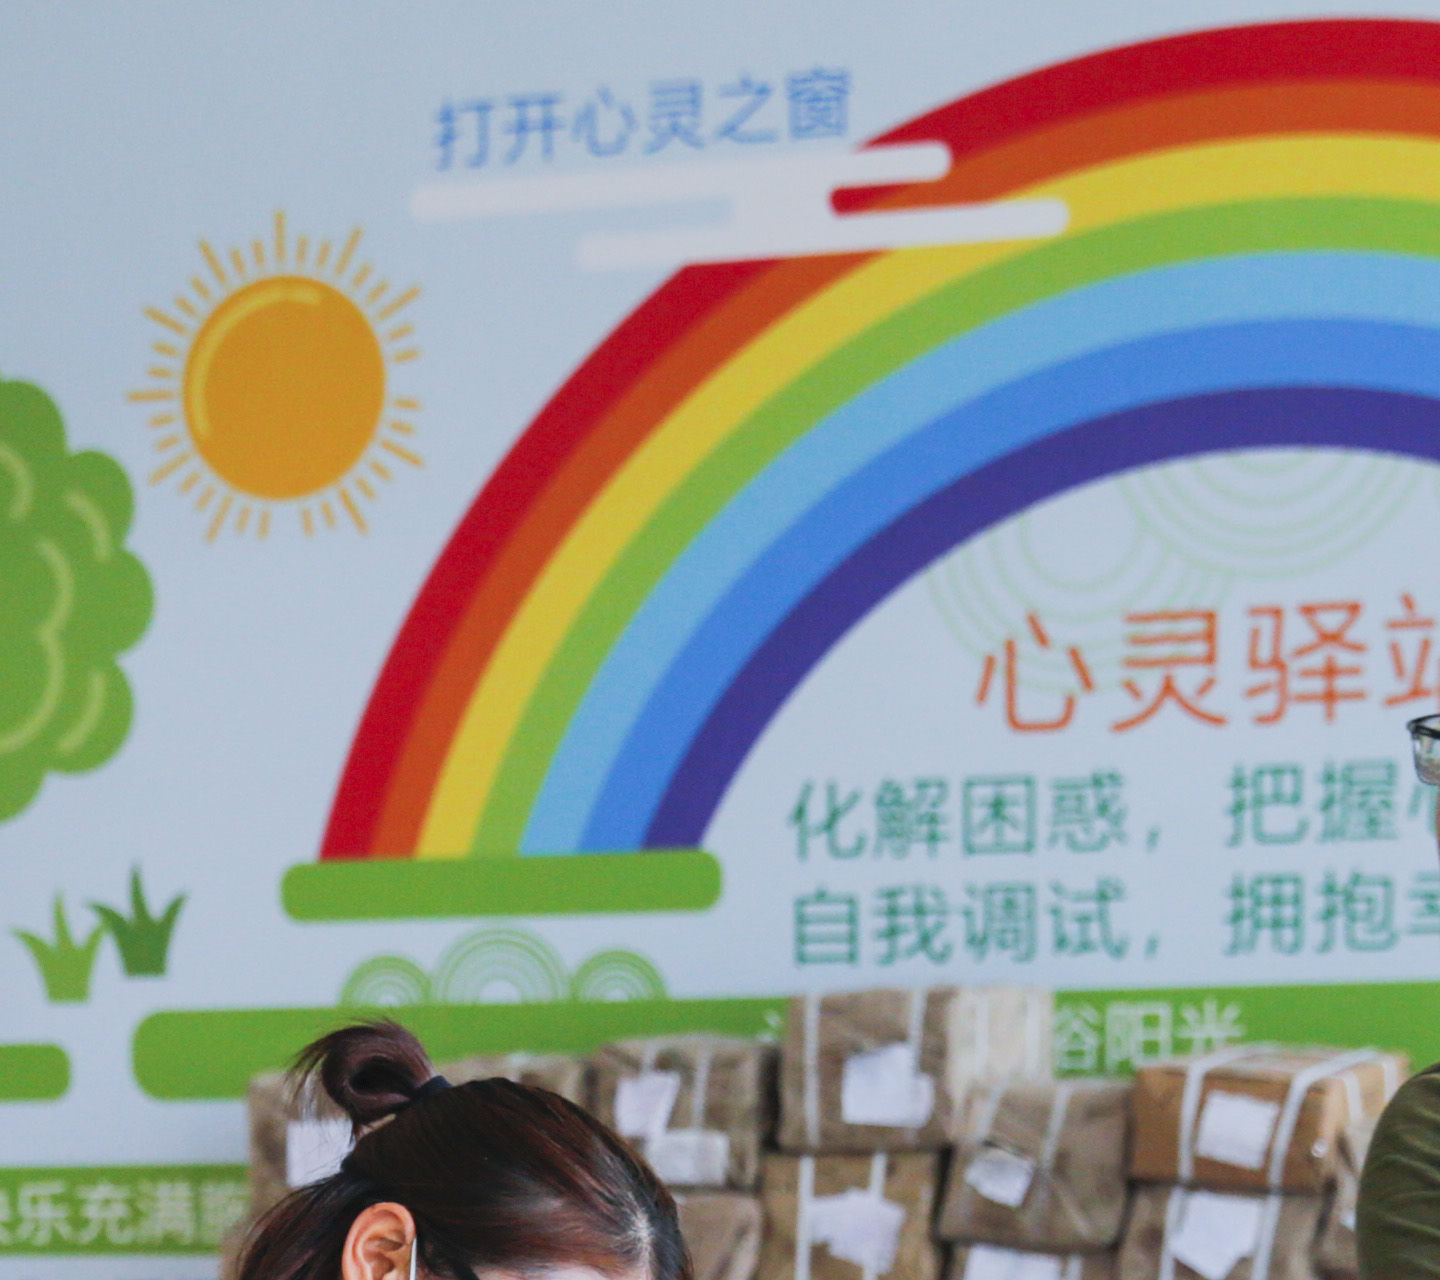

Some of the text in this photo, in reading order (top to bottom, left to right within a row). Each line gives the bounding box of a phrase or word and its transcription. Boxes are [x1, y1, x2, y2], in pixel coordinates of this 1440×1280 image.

[434, 66, 854, 171] 打开心灵之窗
